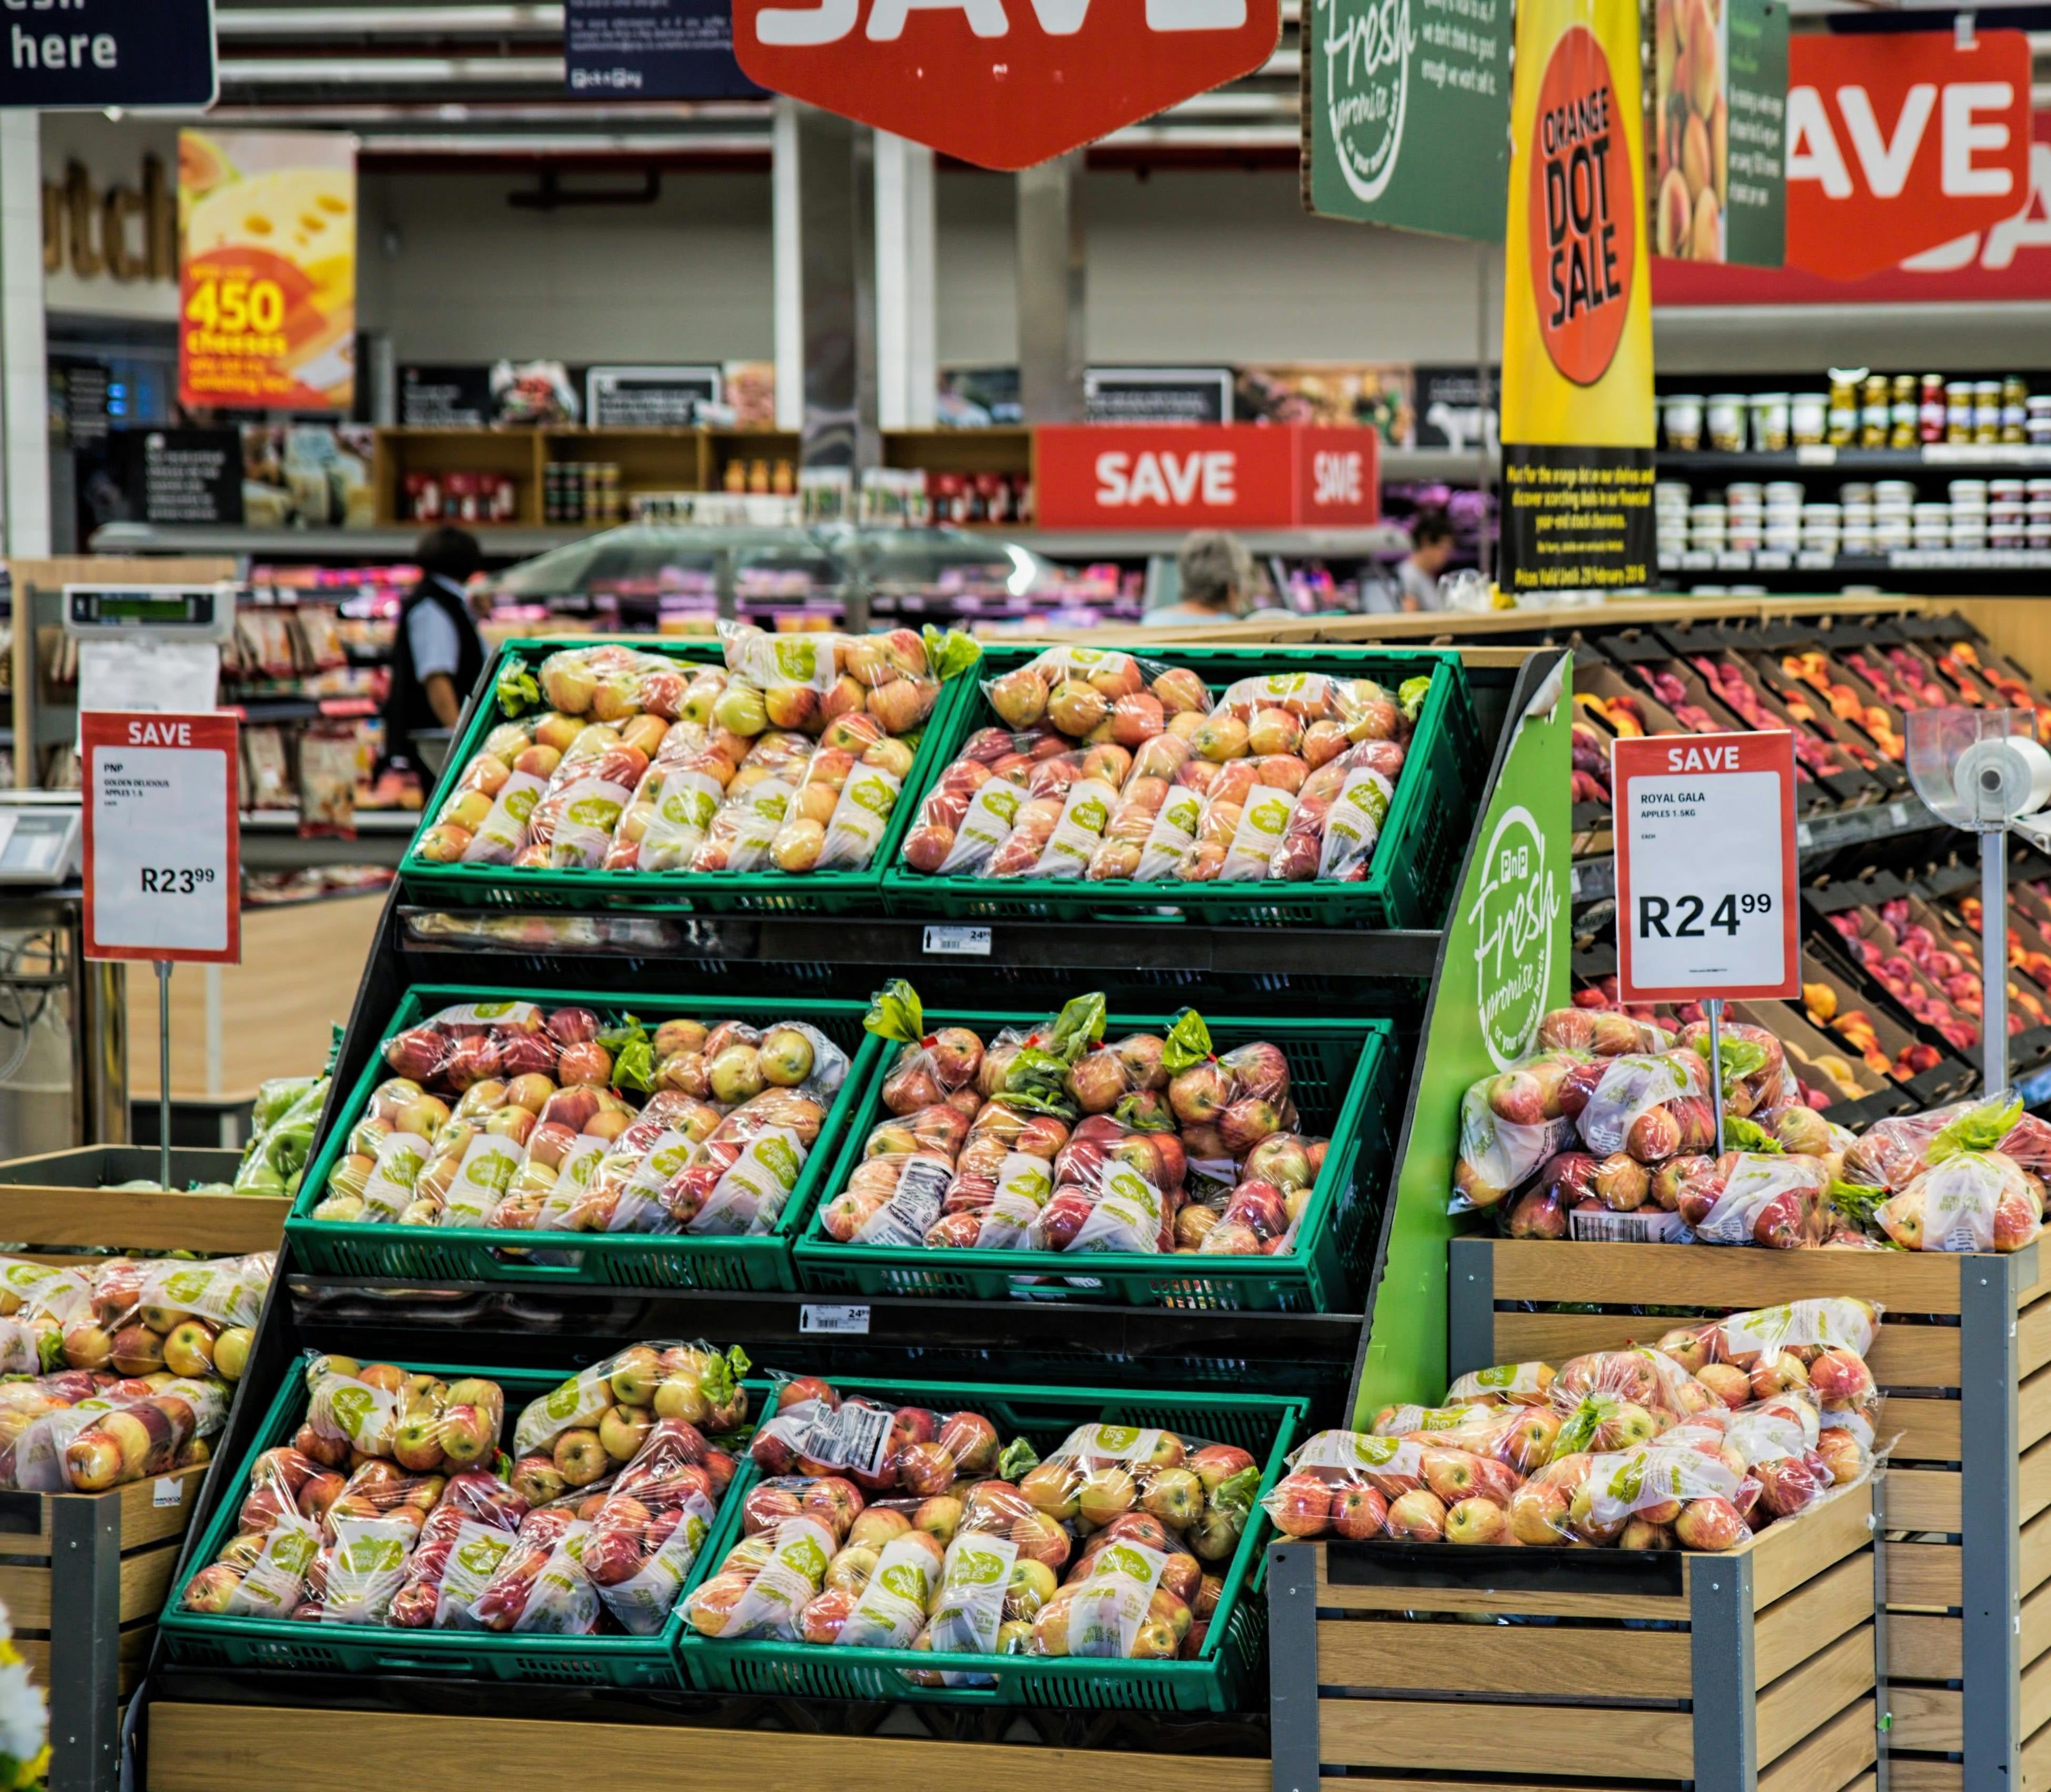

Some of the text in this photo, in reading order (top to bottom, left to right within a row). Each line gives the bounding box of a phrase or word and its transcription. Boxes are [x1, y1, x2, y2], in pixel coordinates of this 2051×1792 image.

[11, 22, 117, 69] here
[1541, 87, 1609, 159] ORANGE
[1787, 82, 2013, 199] AVE
[1544, 135, 1610, 250] DOT
[1549, 223, 1621, 332] SALE
[185, 279, 284, 332] 450
[1095, 451, 1237, 507] SAVE
[1313, 451, 1363, 505] SAVE
[128, 721, 191, 746] SAVE
[104, 763, 123, 773] PNP
[104, 779, 169, 788] GOLDEN DELICIOUS
[1668, 746, 1740, 772] SAVE
[1641, 792, 1705, 804] ROYAL GALA
[1641, 809, 1696, 818] APPLES 1.5KG
[1501, 846, 1528, 884] PnP
[1468, 834, 1560, 979] Fresh
[1485, 963, 1533, 1048] promise
[1495, 948, 1546, 1053] or your money back
[974, 1563, 999, 1573] GALA
[974, 1616, 994, 1628] 1.5 kg
